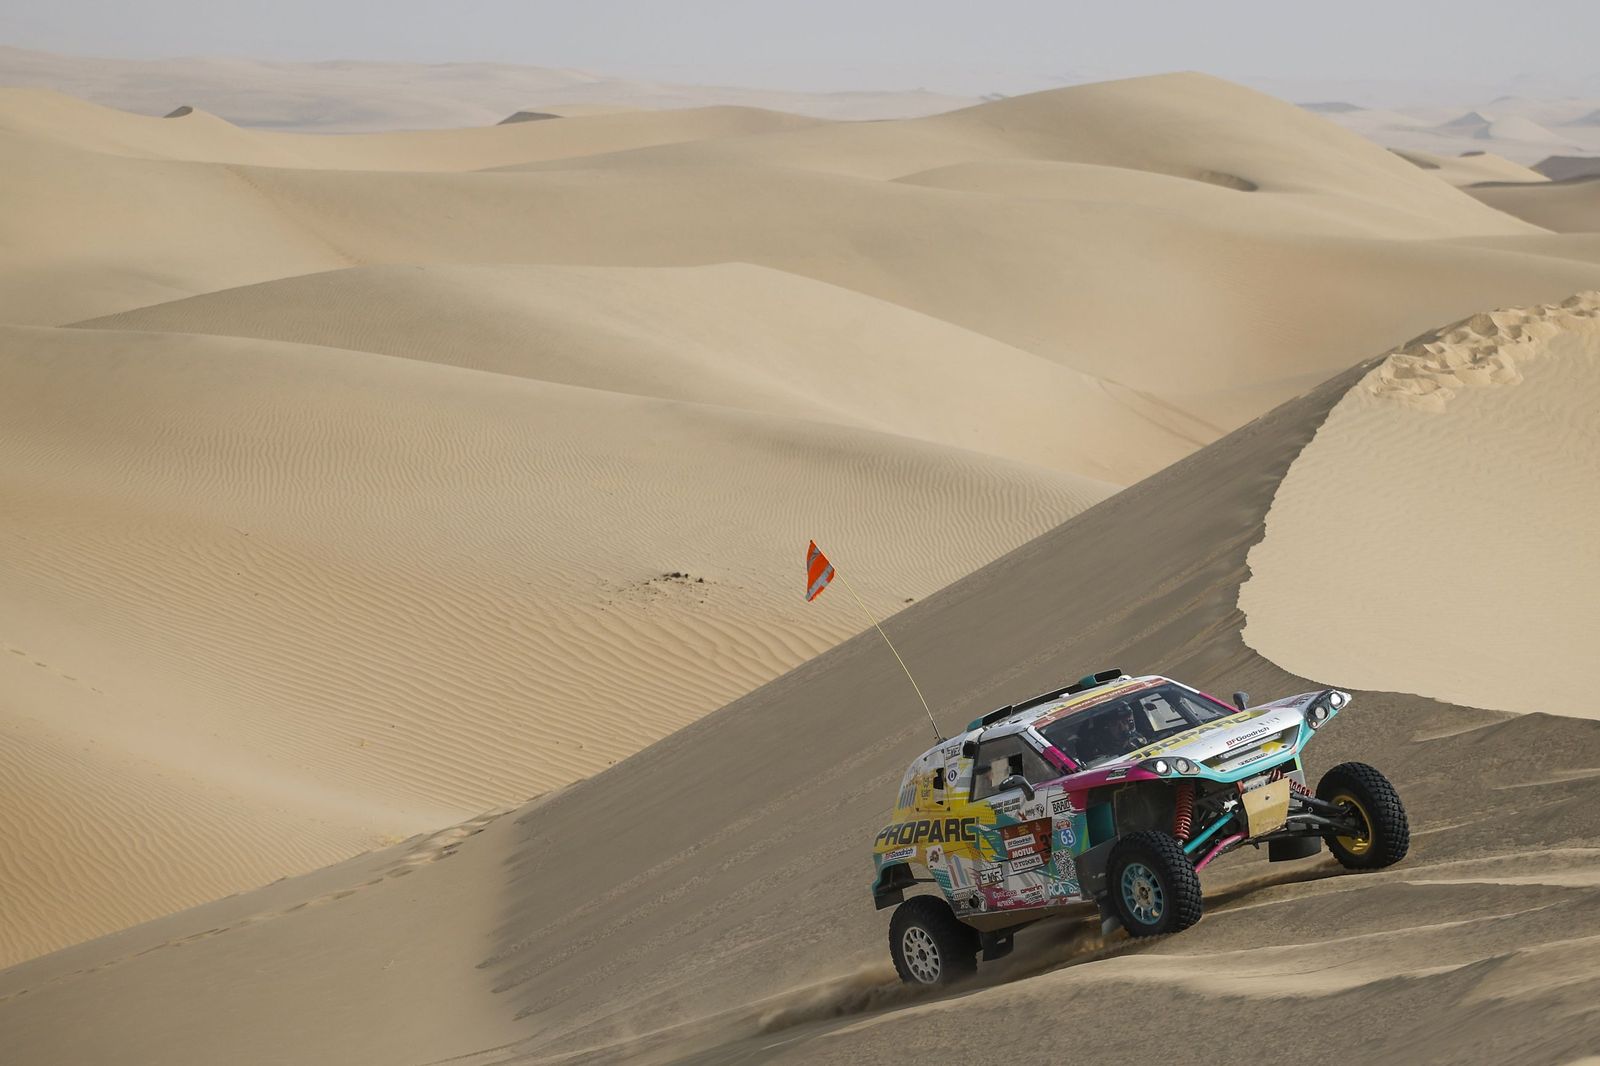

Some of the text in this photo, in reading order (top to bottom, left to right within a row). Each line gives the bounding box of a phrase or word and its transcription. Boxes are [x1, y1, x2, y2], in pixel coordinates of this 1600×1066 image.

[1127, 714, 1252, 761] PROPARC
[1226, 726, 1270, 747] BFGoodrich
[1052, 800, 1071, 813] BRAID
[874, 817, 976, 847] PROPARC
[1060, 830, 1074, 845] 63
[884, 847, 914, 859] BFGoodrich
[1012, 847, 1035, 858] MOTUL
[1047, 882, 1066, 896] RCA
